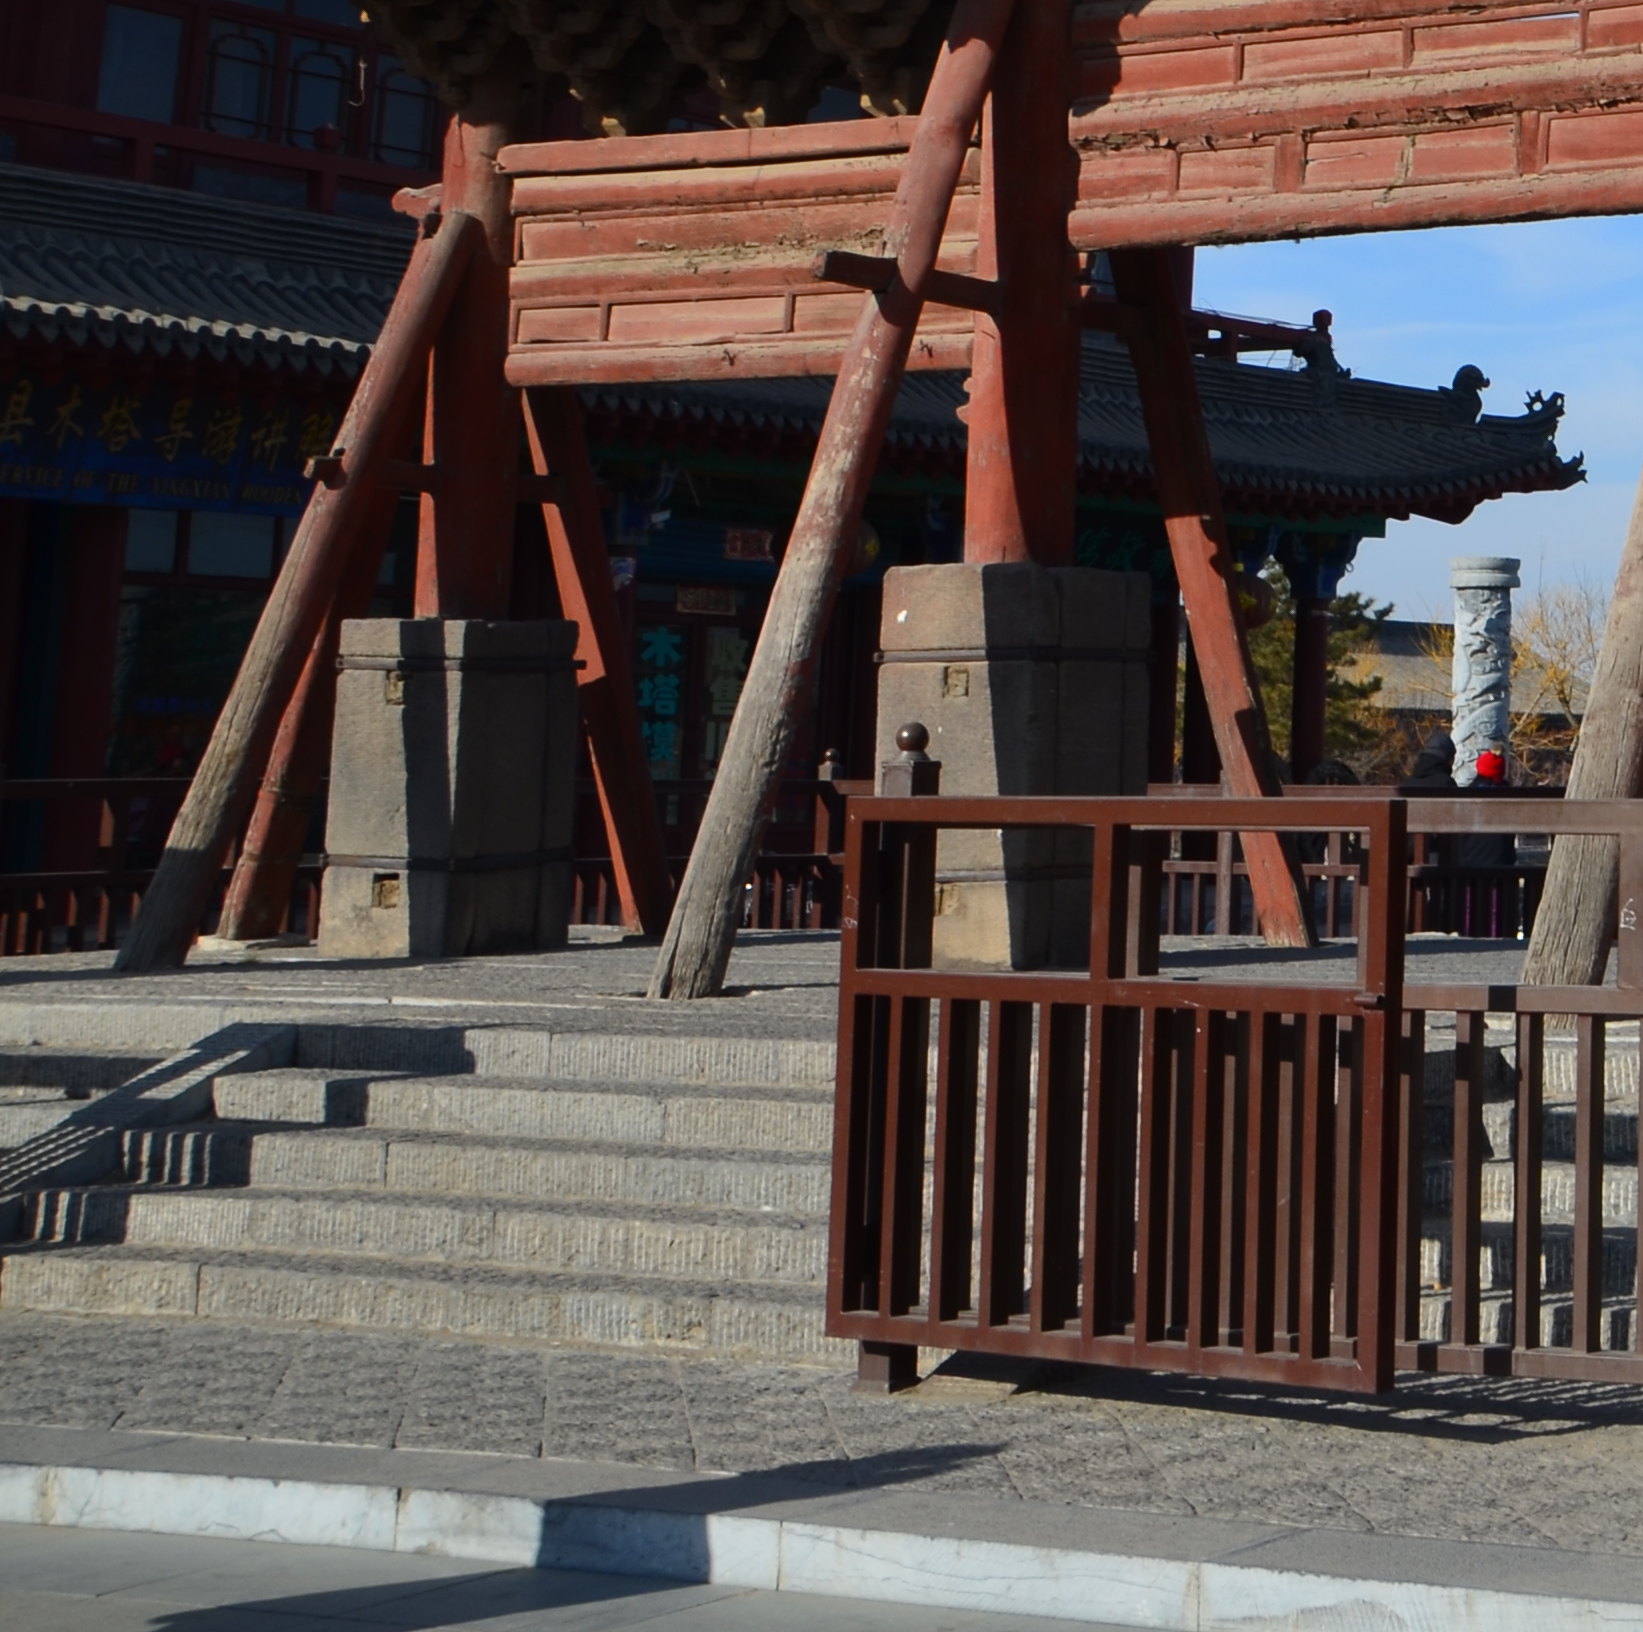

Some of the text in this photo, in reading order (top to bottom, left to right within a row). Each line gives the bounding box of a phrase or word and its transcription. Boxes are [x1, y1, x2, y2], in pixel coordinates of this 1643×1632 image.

[106, 471, 141, 493] THE
[637, 626, 684, 781] 木塔模
